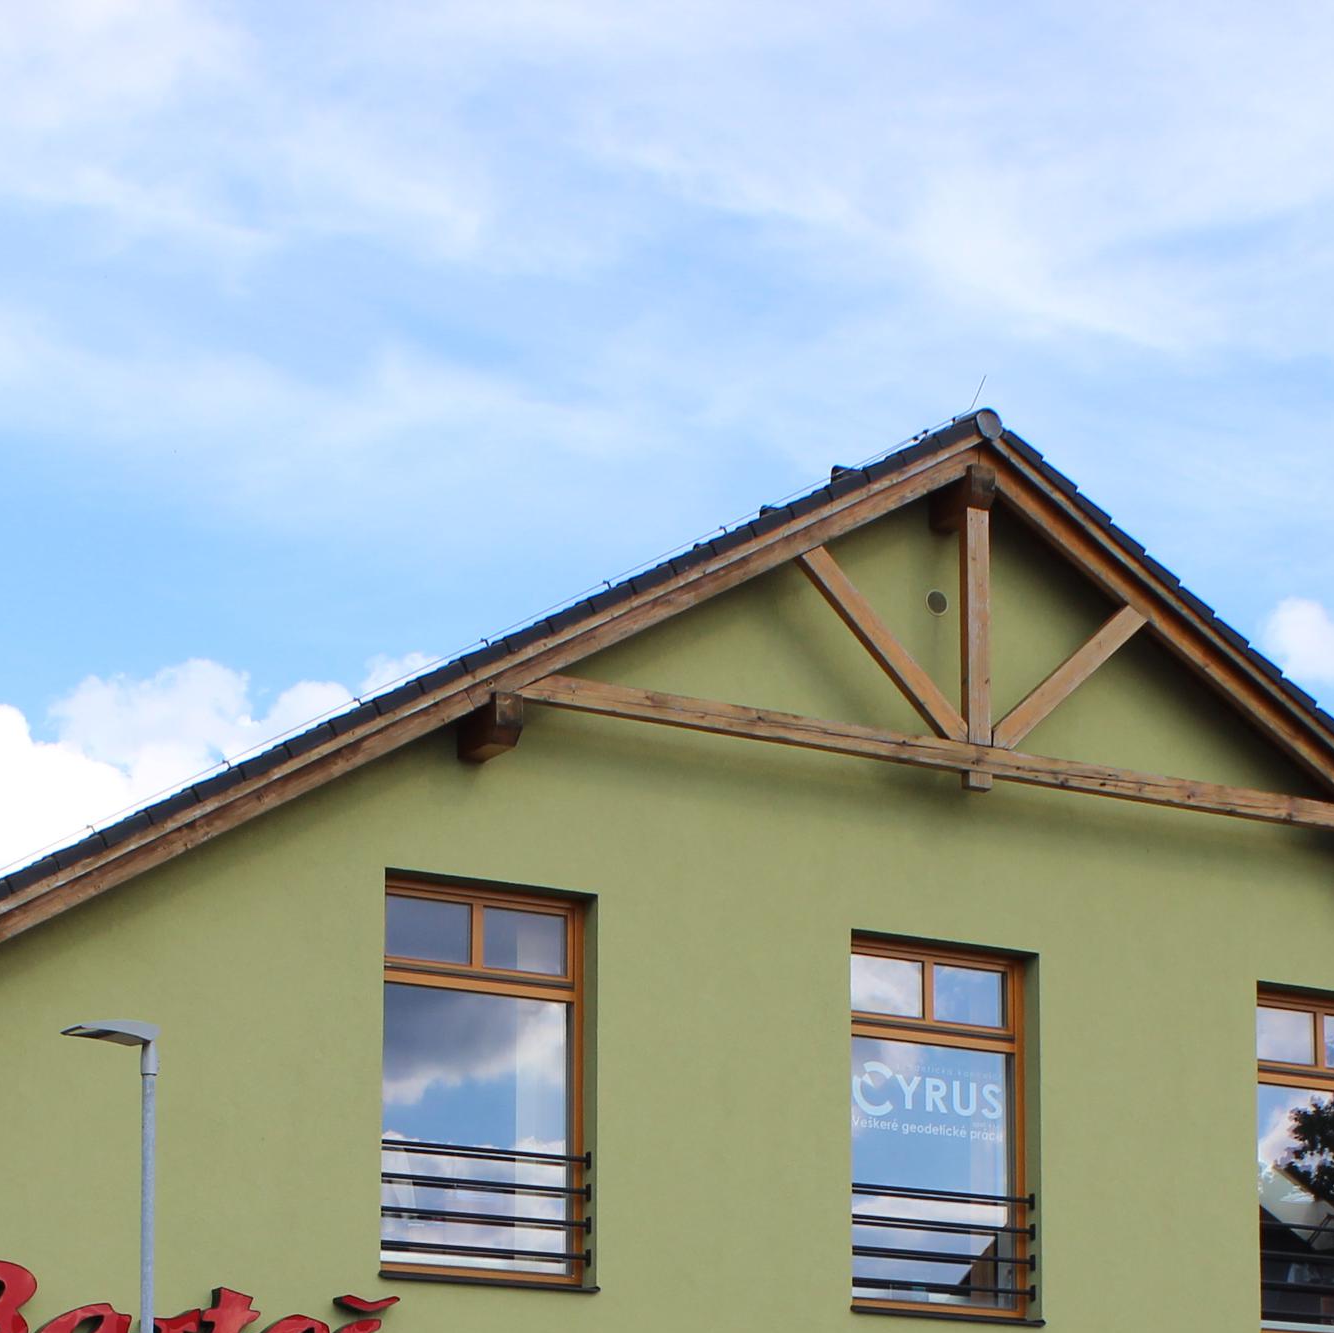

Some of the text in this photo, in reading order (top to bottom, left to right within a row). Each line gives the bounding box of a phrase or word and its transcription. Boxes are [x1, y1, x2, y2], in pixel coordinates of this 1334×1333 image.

[852, 1061, 1003, 1120] CYRUS
[852, 1116, 899, 1131] Veškeré
[901, 1121, 966, 1138] geodetické
